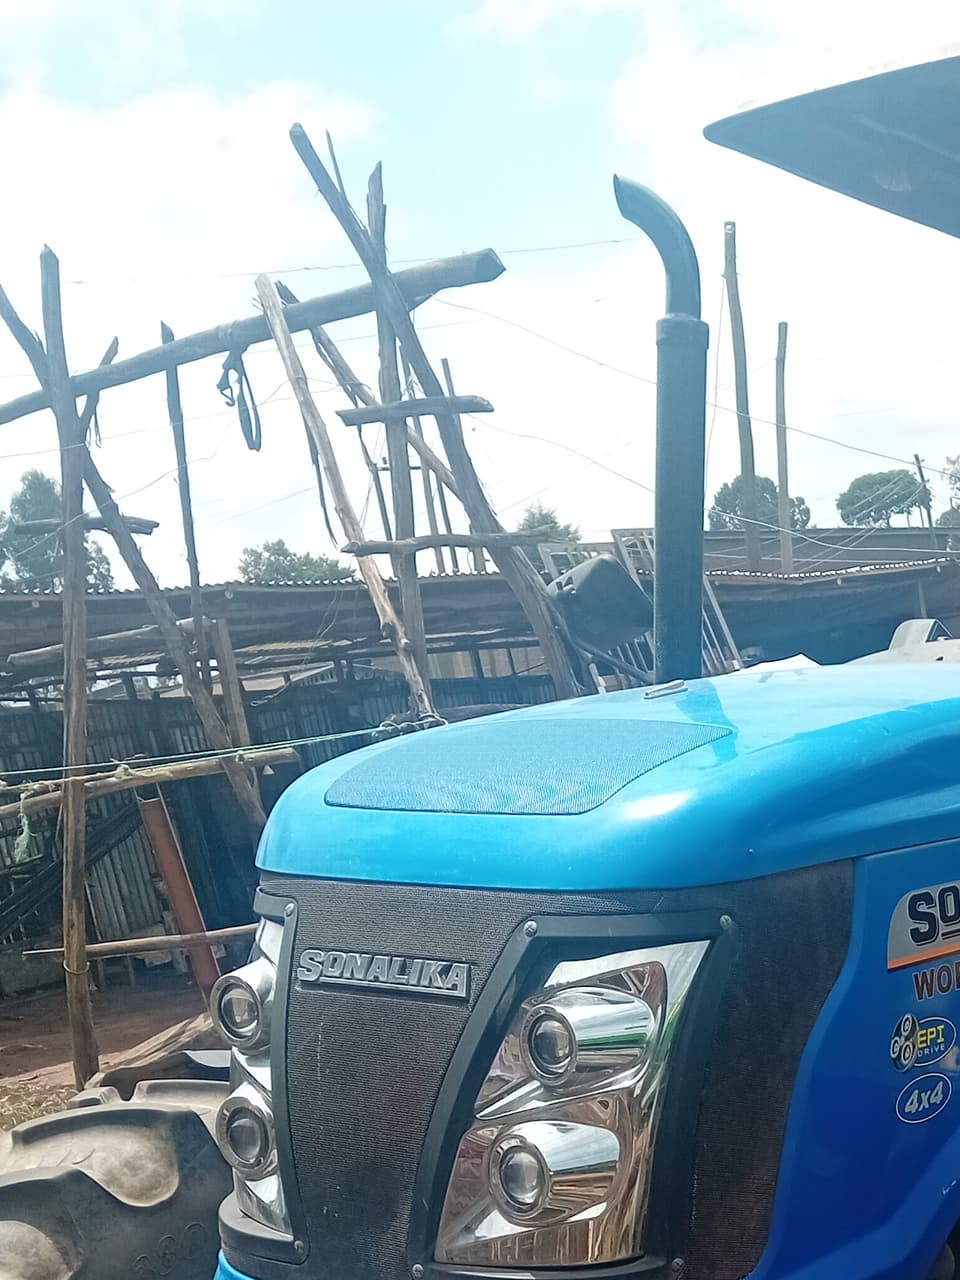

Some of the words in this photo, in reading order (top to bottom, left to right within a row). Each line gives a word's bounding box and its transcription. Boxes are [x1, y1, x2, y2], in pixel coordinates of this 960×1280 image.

[297, 950, 470, 997] SONALIKA
[917, 1025, 945, 1049] EPI
[917, 1043, 945, 1058] DRIVE
